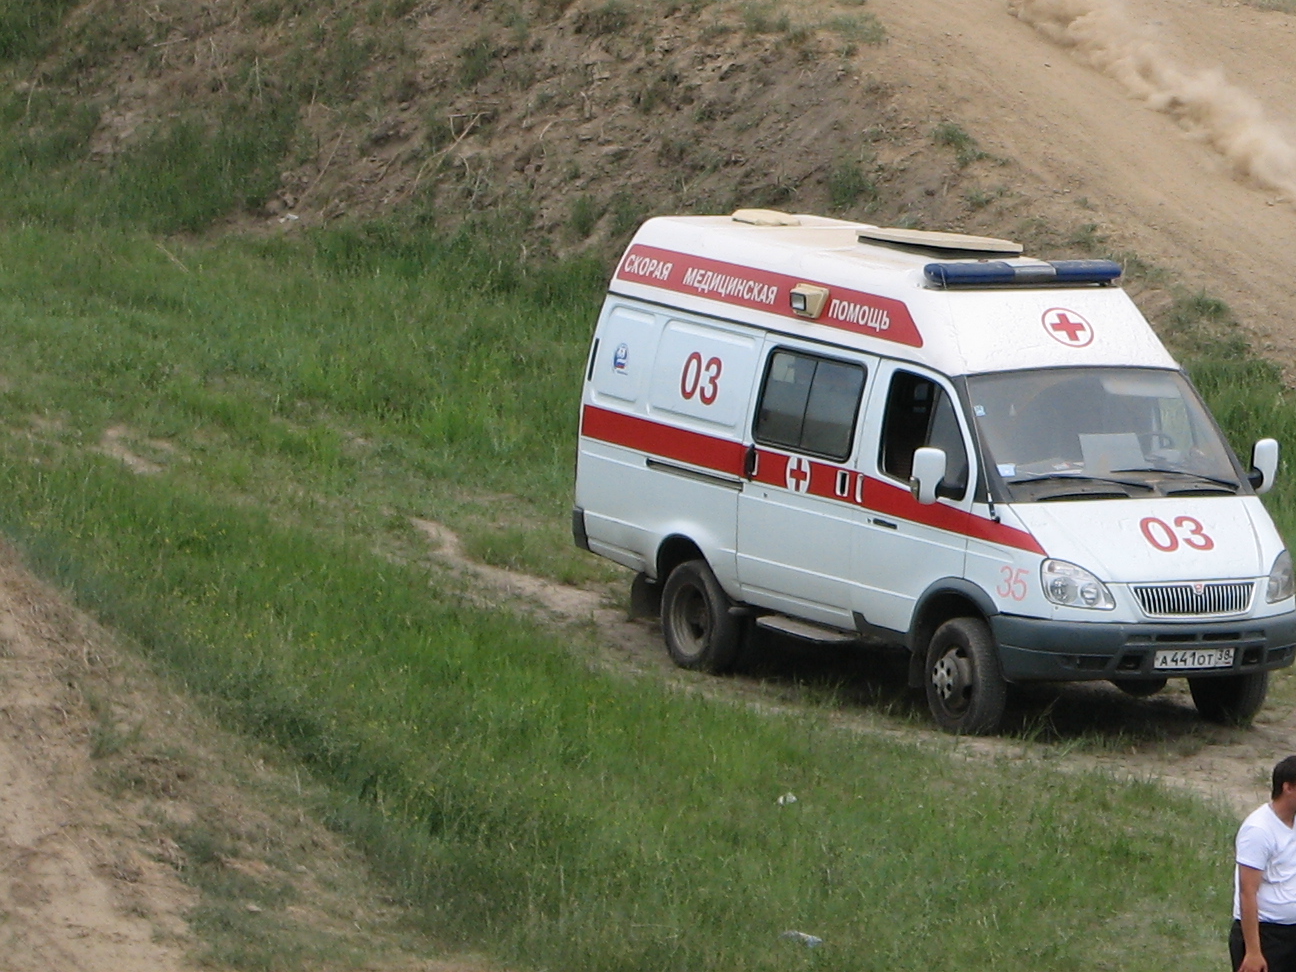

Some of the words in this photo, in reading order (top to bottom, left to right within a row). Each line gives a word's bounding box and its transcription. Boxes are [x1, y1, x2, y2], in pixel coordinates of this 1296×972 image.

[624, 254, 673, 281] СКОРАЯ
[682, 267, 778, 305] МЕДИЦИНСКАЯ
[828, 298, 890, 332] ПОМОЩЬ
[681, 351, 722, 405] 03
[1139, 516, 1215, 552] 03
[996, 565, 1029, 601] 35
